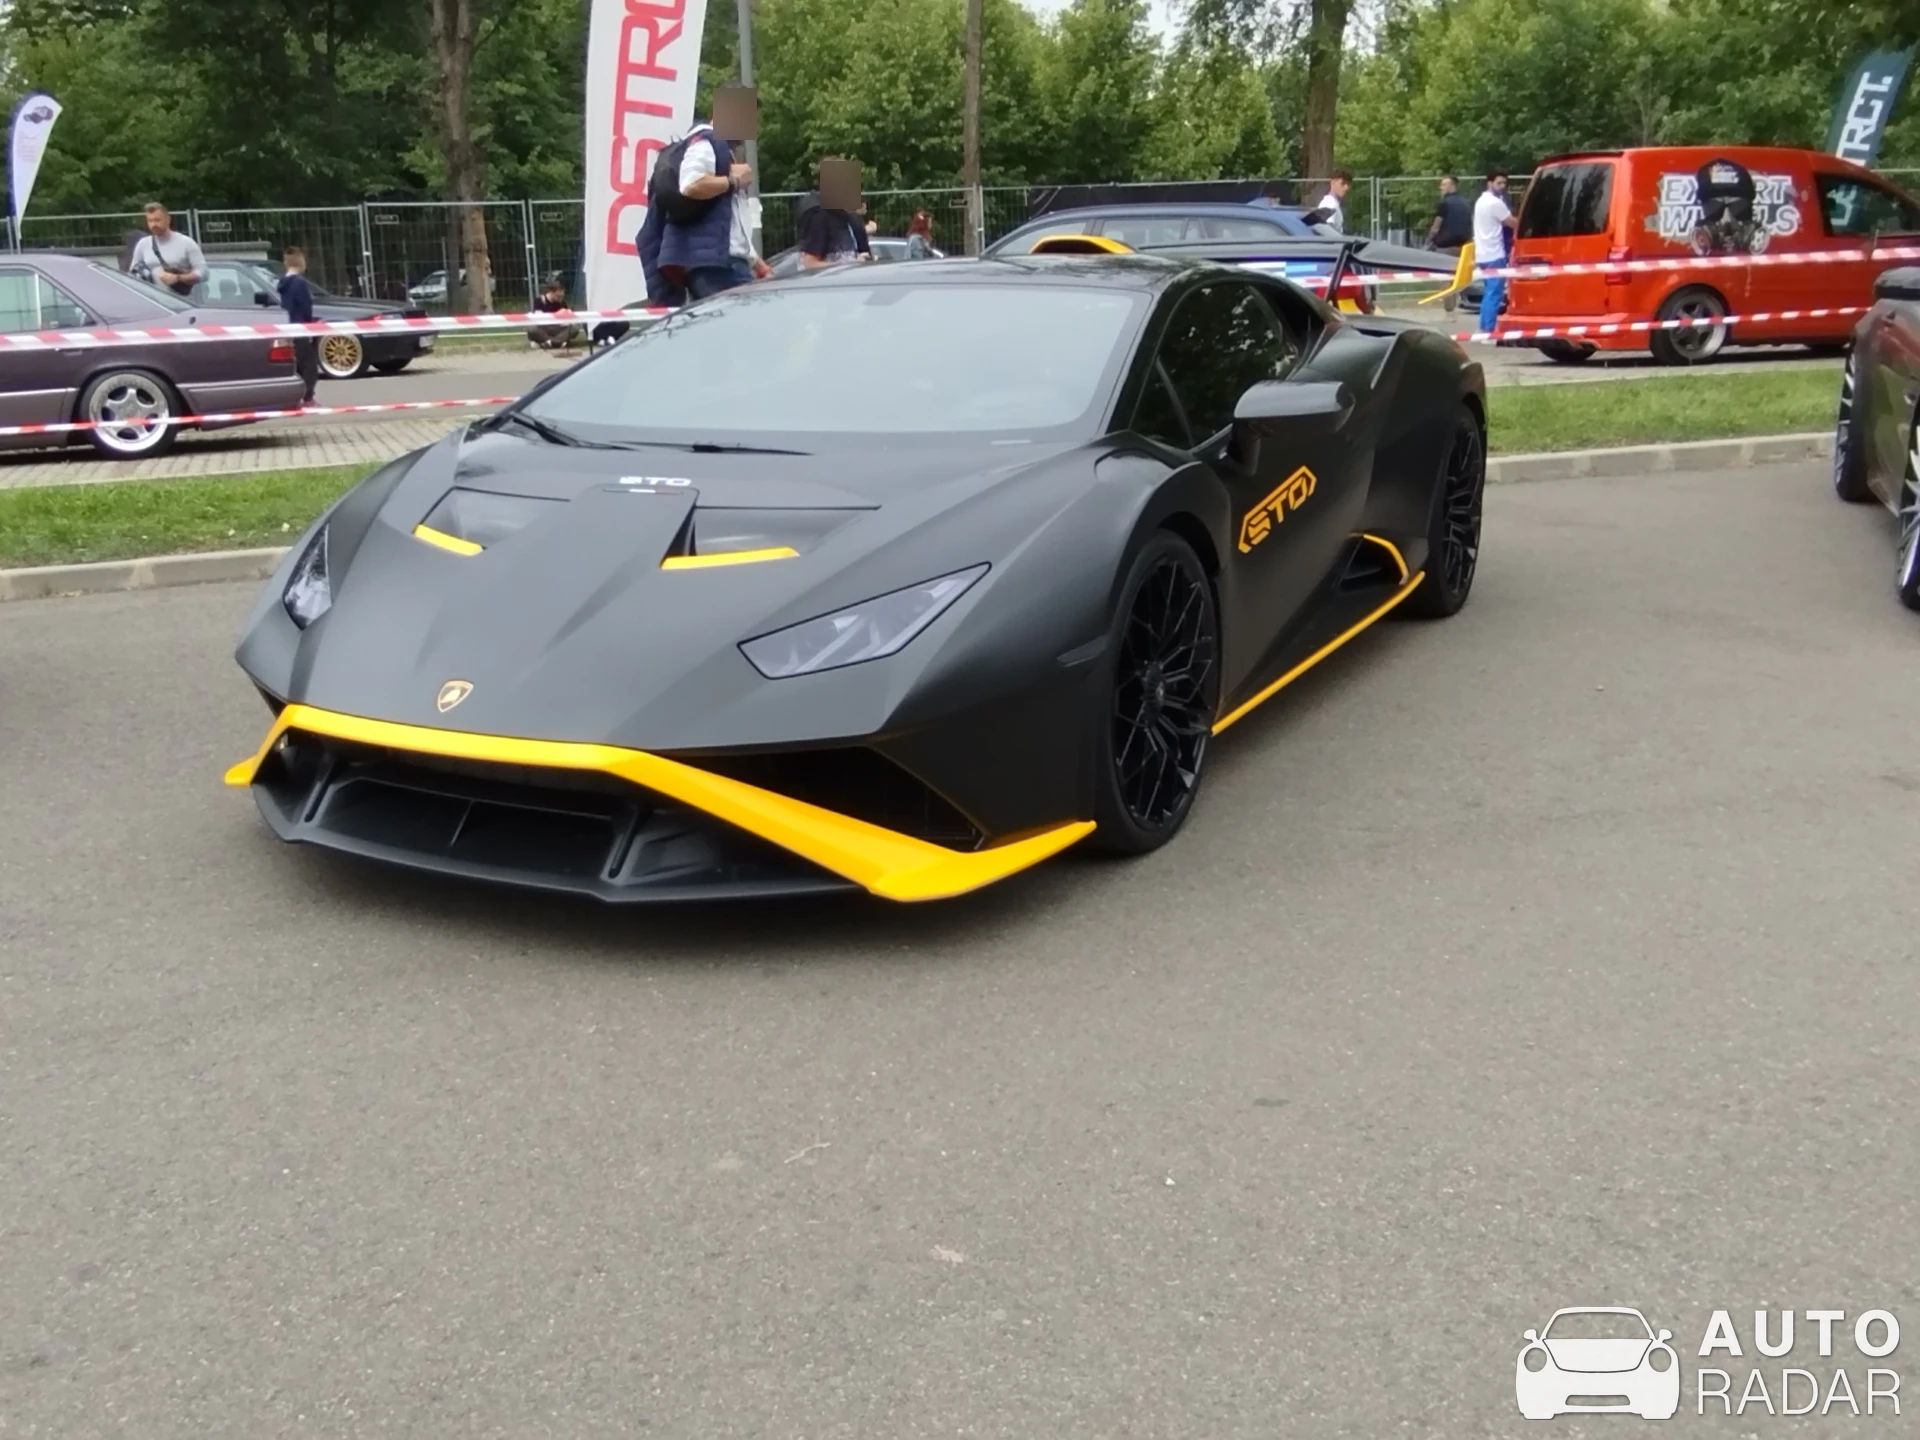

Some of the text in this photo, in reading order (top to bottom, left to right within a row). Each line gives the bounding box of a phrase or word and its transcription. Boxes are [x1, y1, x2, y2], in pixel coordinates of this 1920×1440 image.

[1662, 174, 1793, 205] EXRT
[619, 475, 692, 487] STO
[1247, 475, 1309, 546] STO
